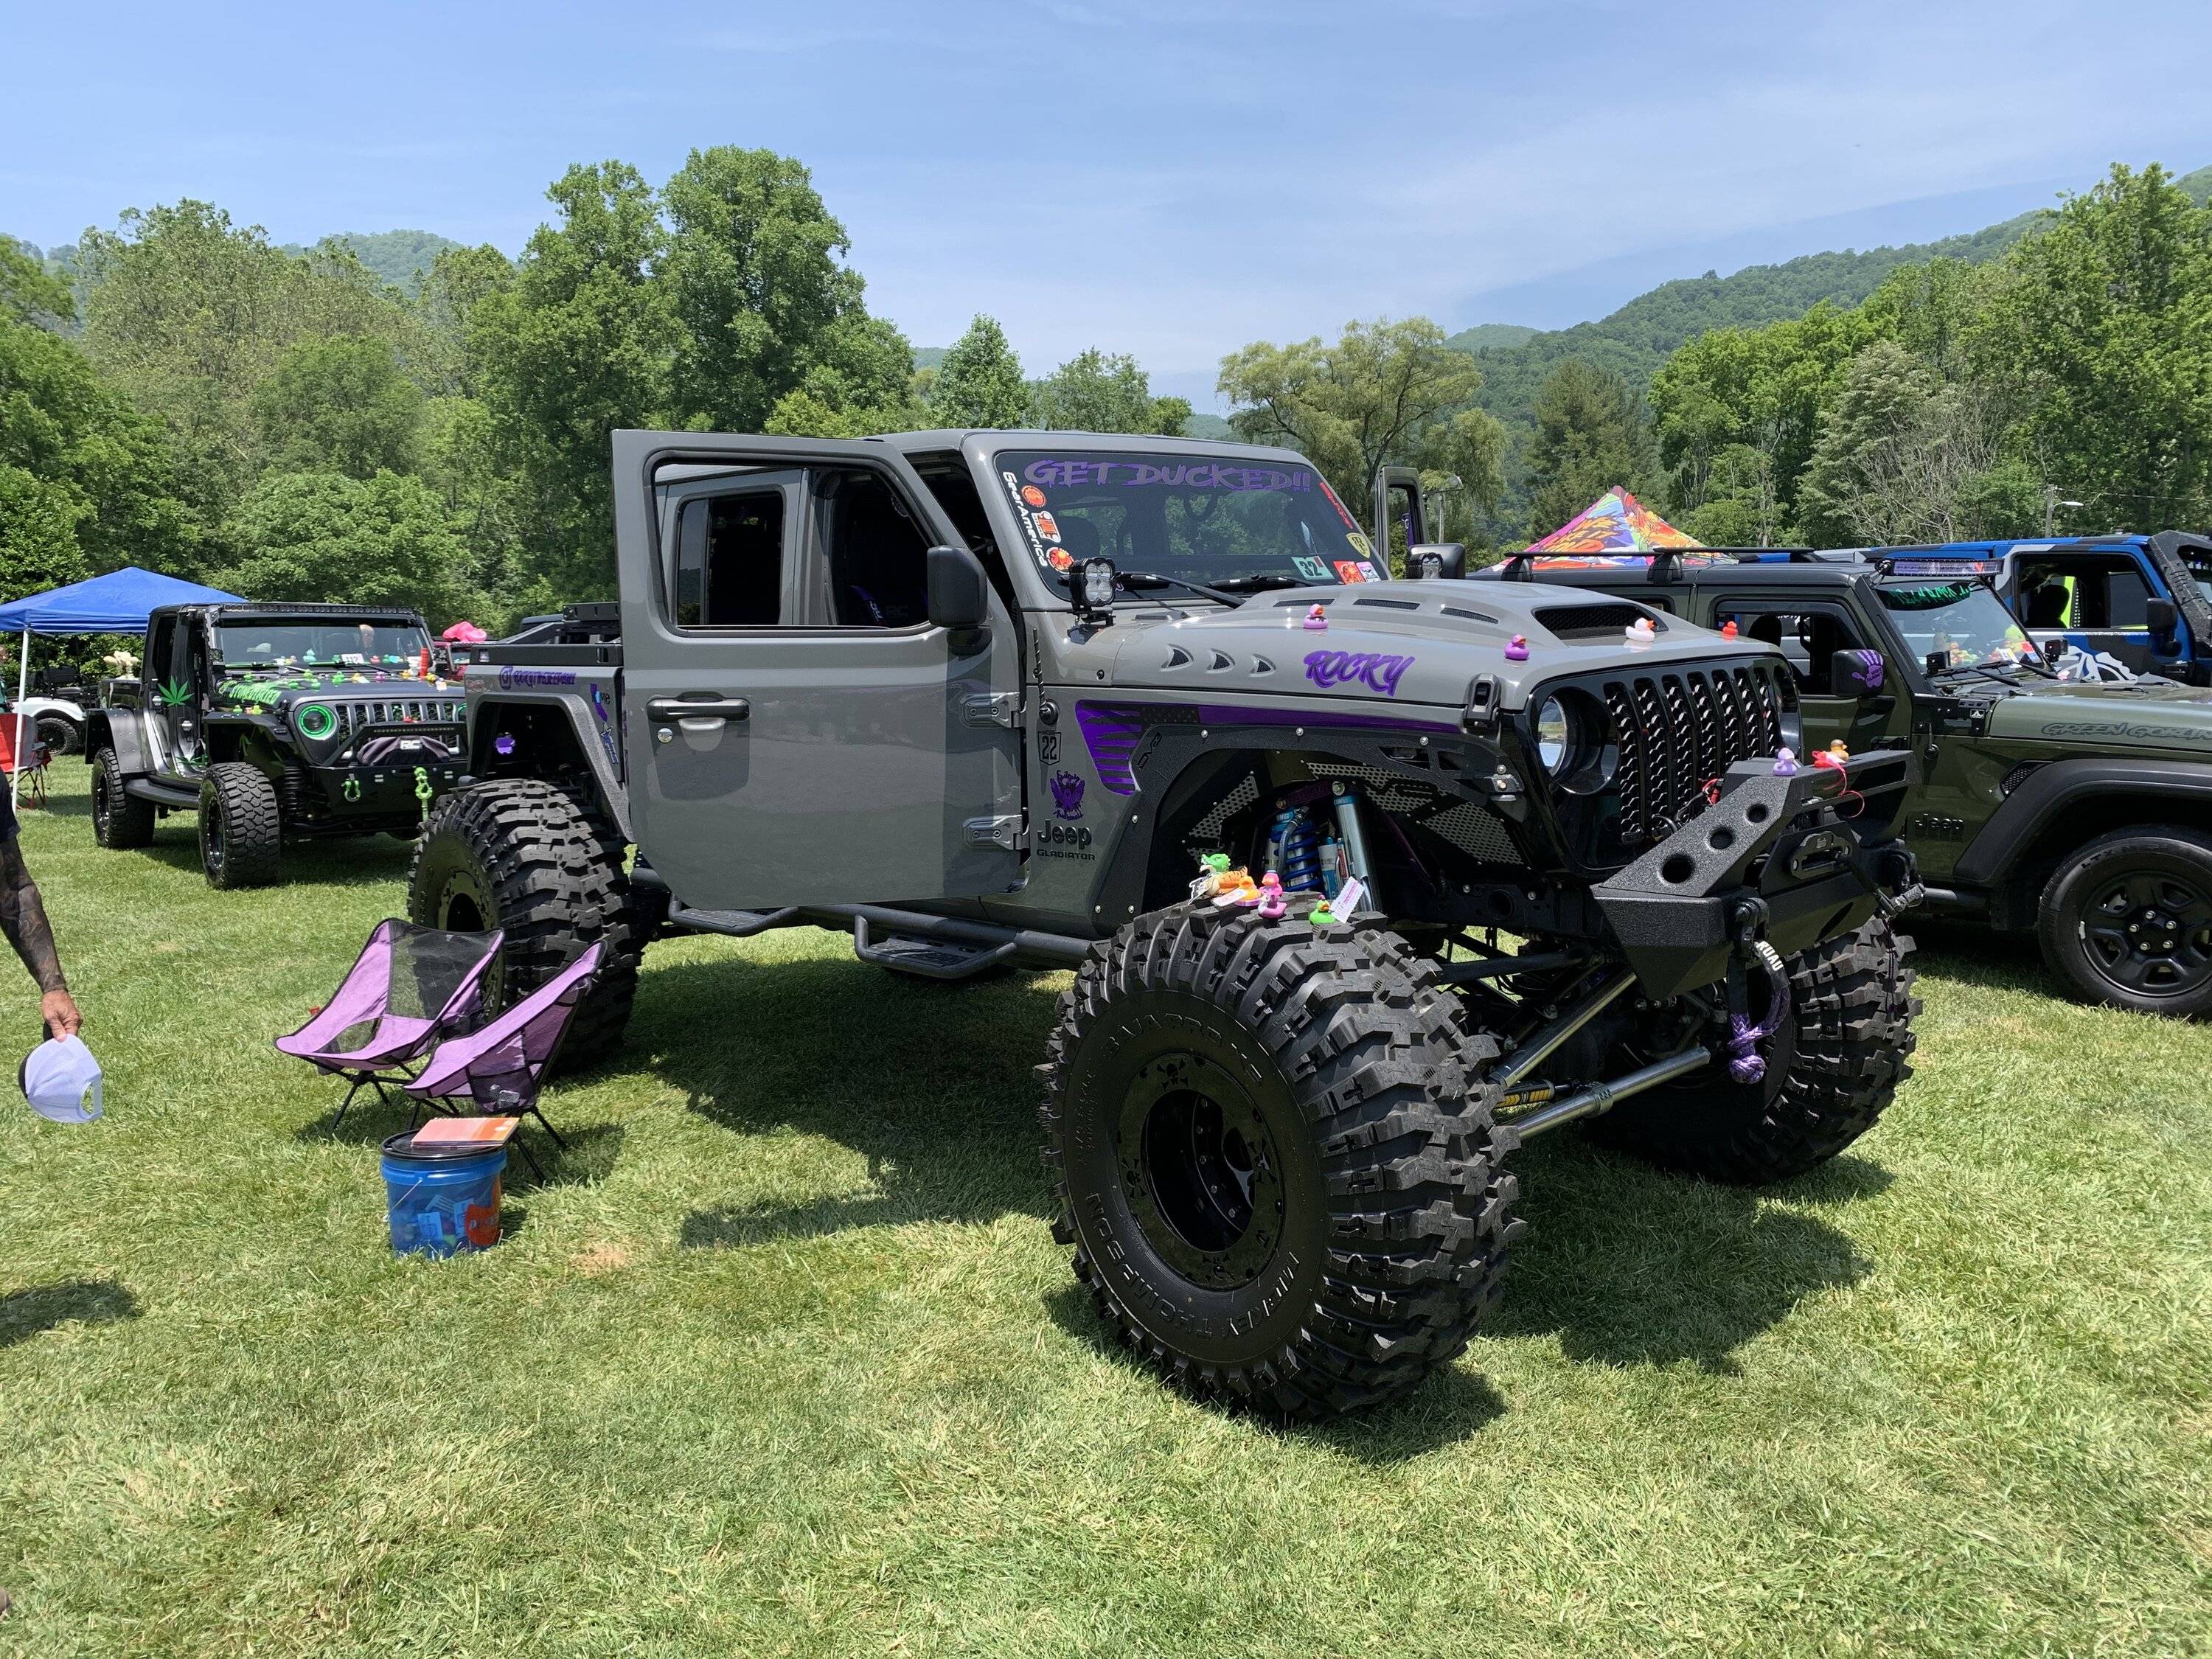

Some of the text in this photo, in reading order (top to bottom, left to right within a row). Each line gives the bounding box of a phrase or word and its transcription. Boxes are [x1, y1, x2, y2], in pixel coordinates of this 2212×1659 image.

[1024, 460, 1310, 492] GET DUCKED!!
[1002, 471, 1048, 567] GearAmerica
[1298, 560, 1323, 575] 32
[1304, 650, 1416, 697] ROCKY
[2041, 723, 2128, 736] GREEN
[1042, 736, 1057, 760] 22
[1037, 819, 1092, 849] Jeep
[1037, 849, 1096, 861] GLADIATOR
